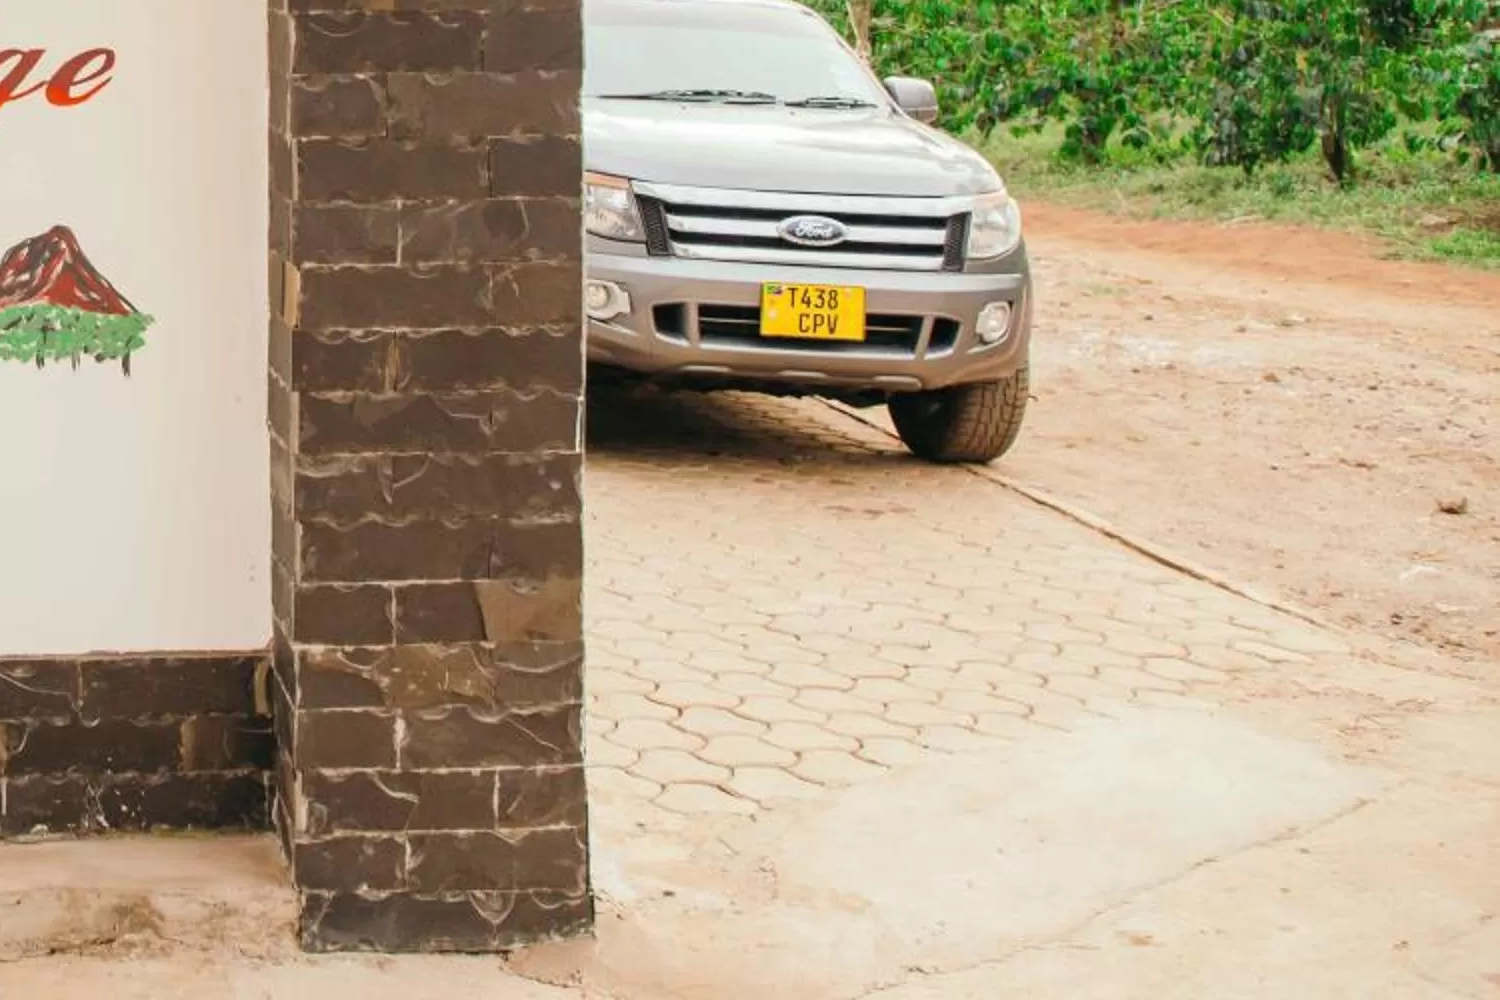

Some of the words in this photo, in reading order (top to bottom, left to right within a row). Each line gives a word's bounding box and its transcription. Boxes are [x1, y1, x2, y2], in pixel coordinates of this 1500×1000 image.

[795, 221, 834, 239] Ford
[787, 287, 839, 310] T438
[798, 313, 839, 335] CPV
